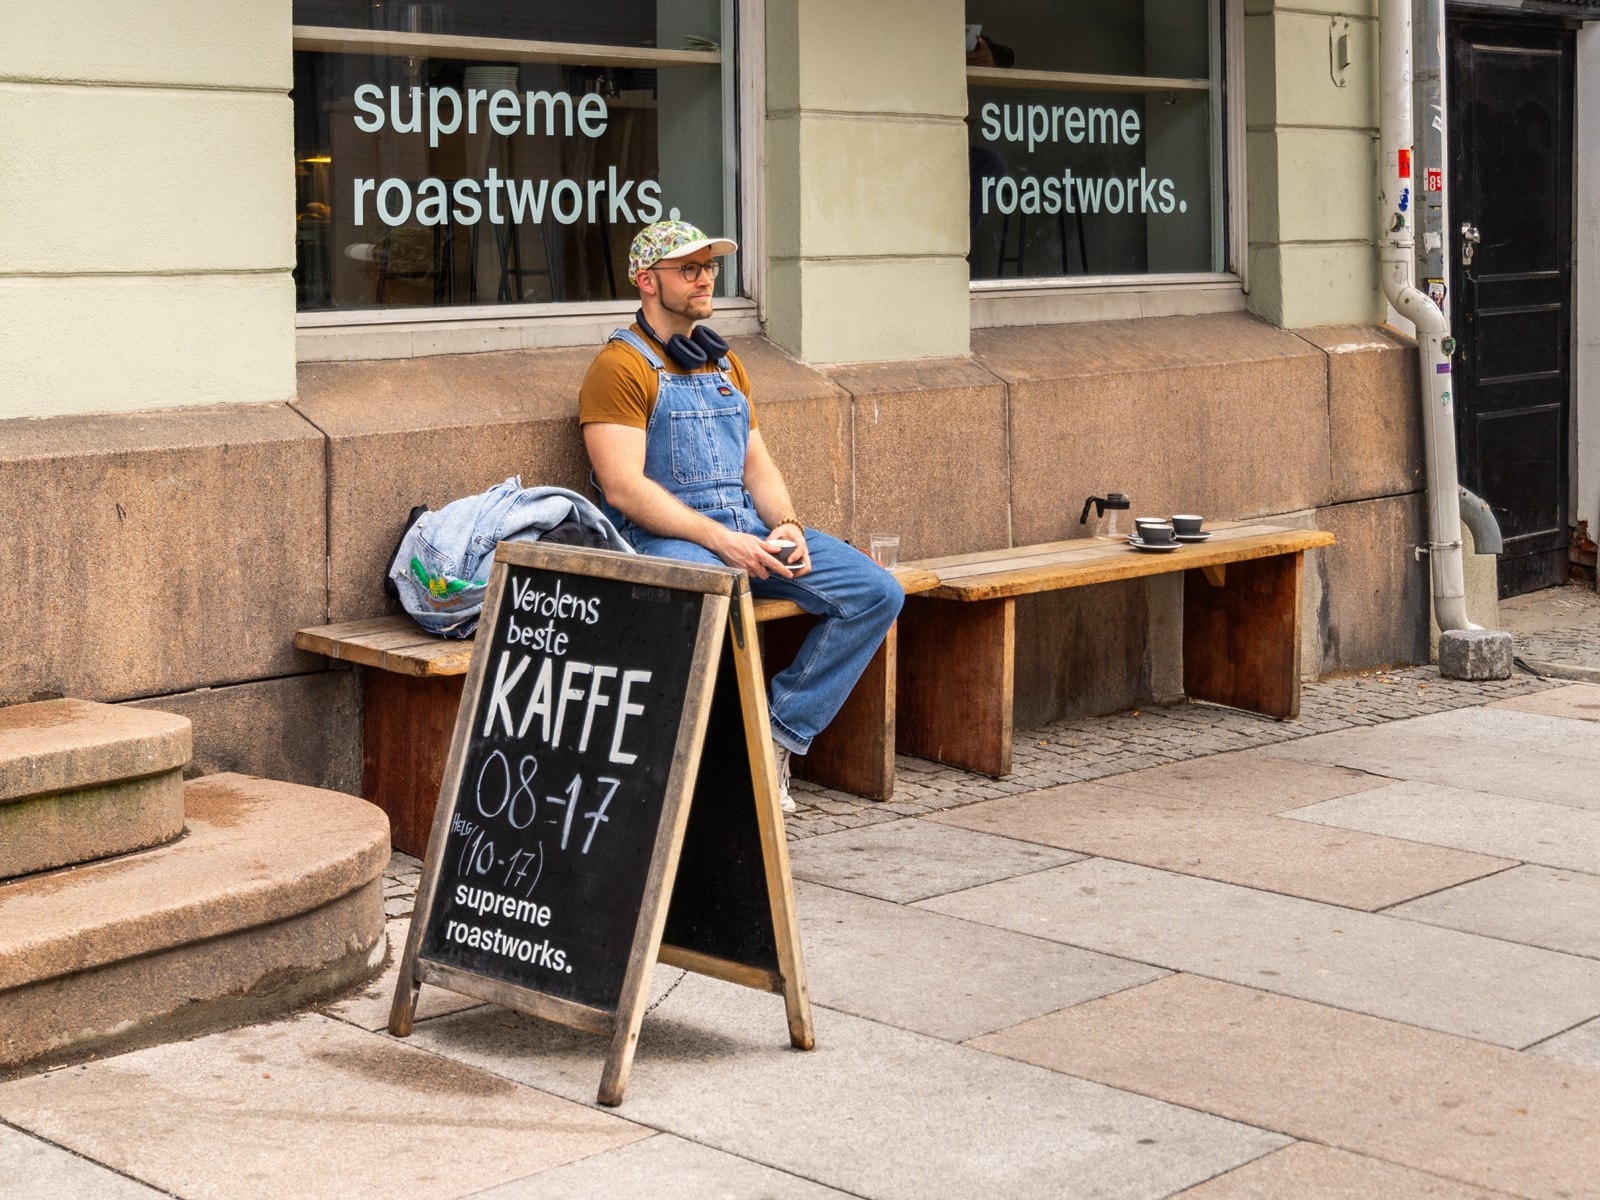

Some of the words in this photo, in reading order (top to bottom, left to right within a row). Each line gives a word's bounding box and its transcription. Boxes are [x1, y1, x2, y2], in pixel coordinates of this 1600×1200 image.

[353, 83, 608, 148] supreme
[981, 102, 1140, 153] supreme
[353, 165, 682, 227] roastworks.
[981, 167, 1187, 215] roastworks.
[511, 576, 600, 625] Verdens
[506, 615, 569, 656] beste
[483, 650, 652, 765] KAFFE
[455, 884, 552, 927] supreme
[446, 920, 573, 974] roastworks.
